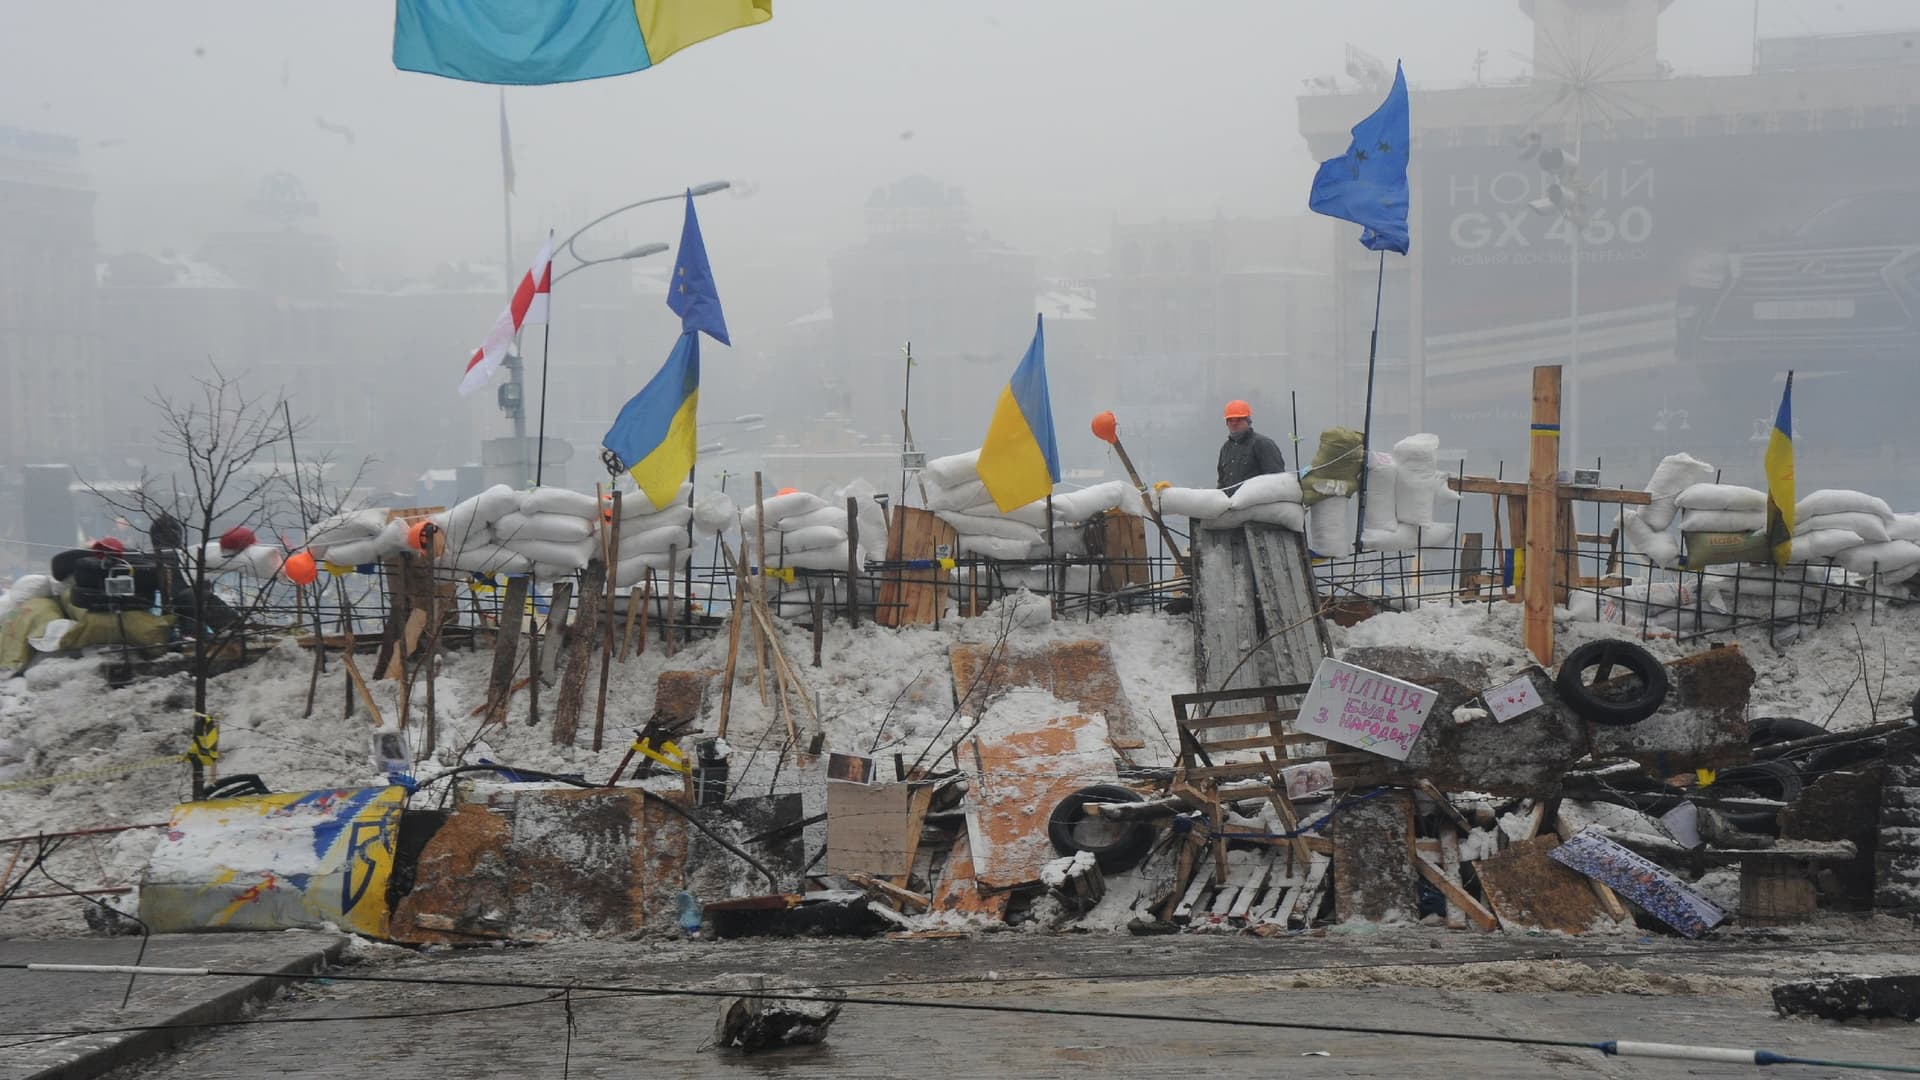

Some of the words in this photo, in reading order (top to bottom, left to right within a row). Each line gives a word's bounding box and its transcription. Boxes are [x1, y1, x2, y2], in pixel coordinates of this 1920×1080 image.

[1449, 210, 1531, 249] GX
[1543, 205, 1654, 245] 460
[1344, 697, 1399, 724] БУДЬ
